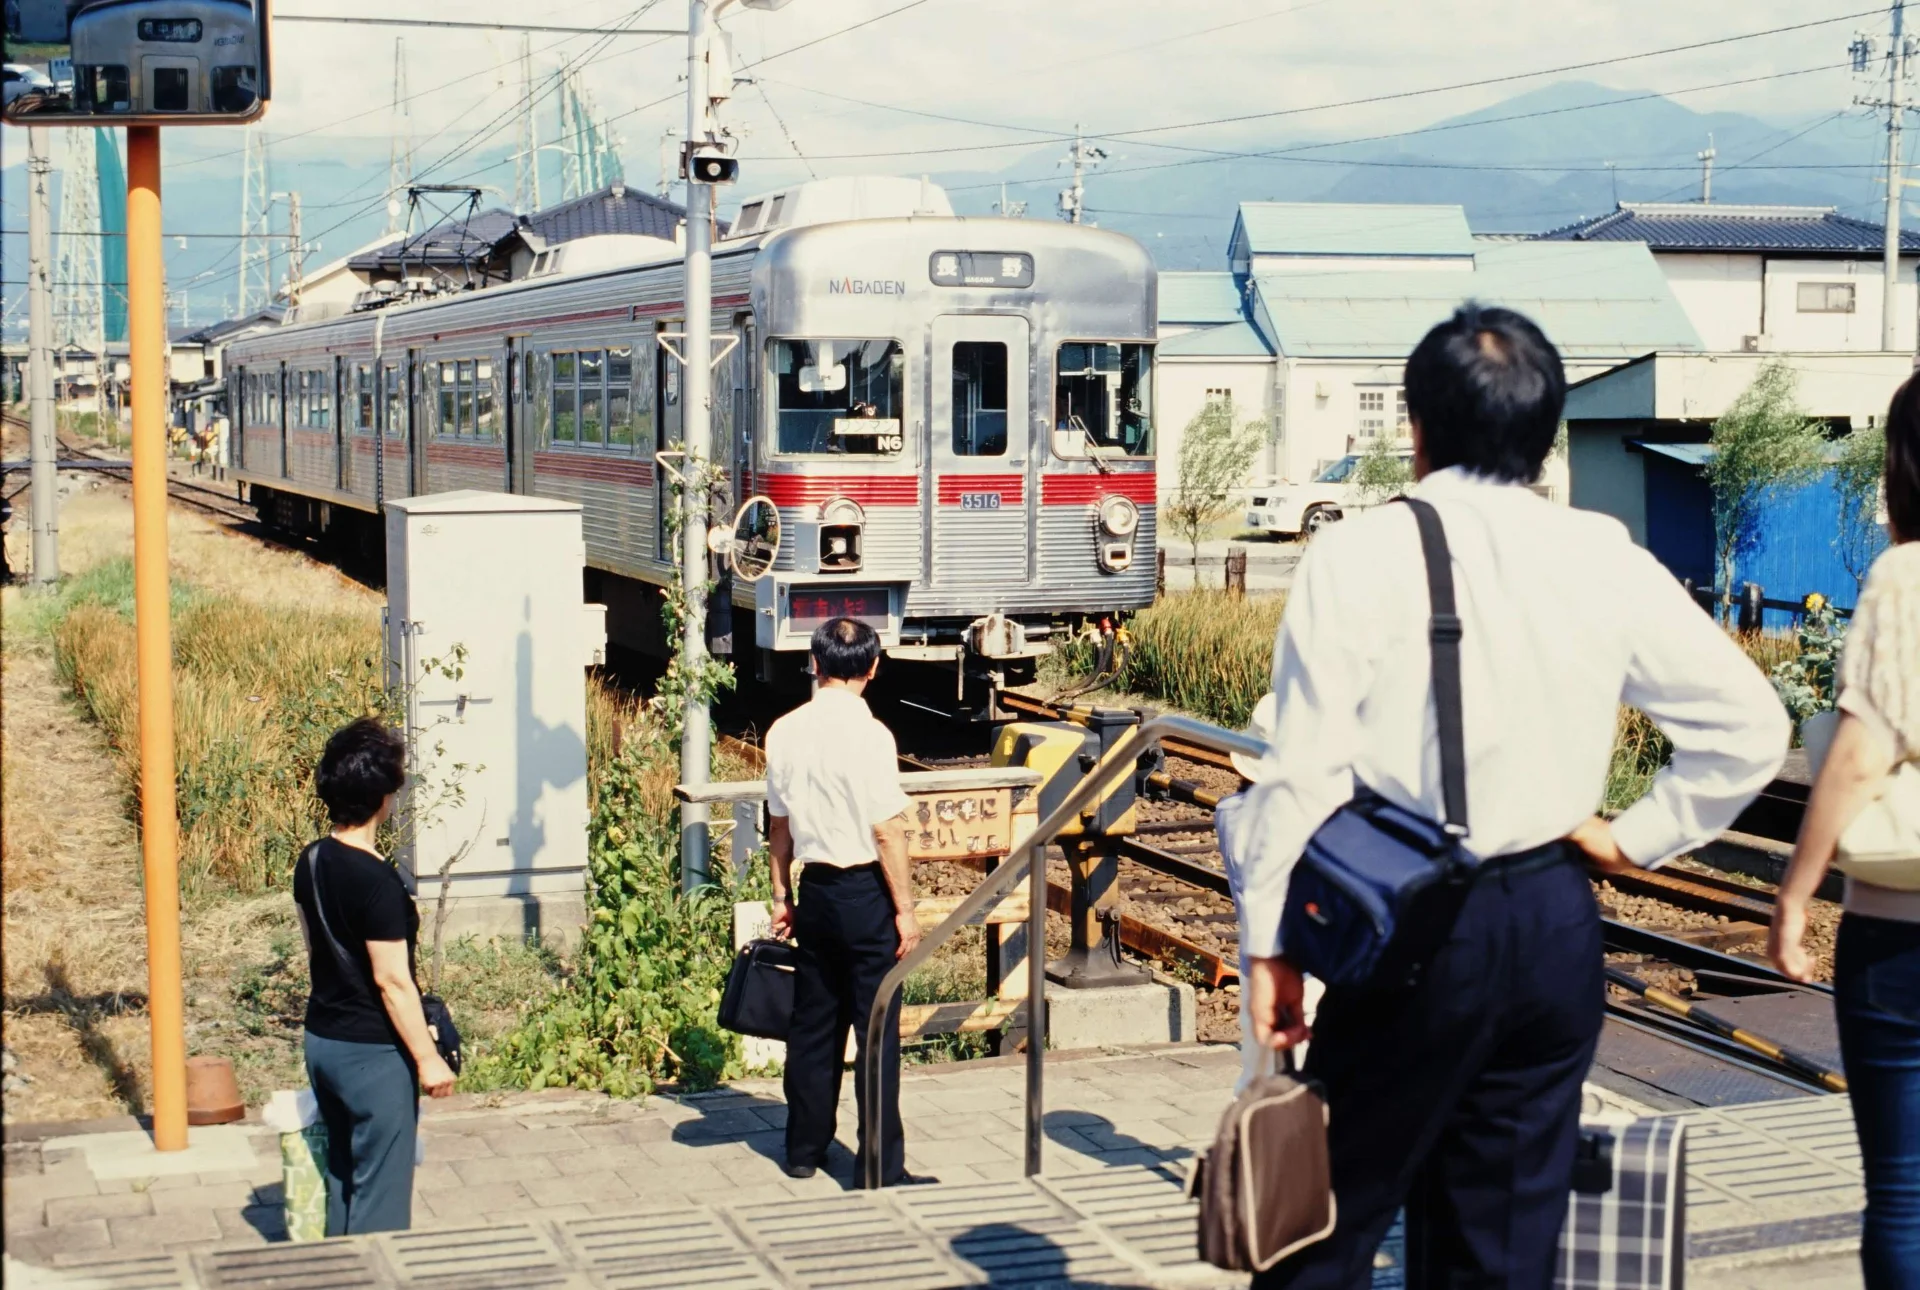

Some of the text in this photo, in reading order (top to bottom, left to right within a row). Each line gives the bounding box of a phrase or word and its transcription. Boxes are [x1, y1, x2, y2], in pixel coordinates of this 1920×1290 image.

[829, 277, 905, 295] NAGADEN
[964, 276, 995, 284] NAGANO
[838, 420, 894, 433] ワンマン
[877, 435, 903, 450] N6
[964, 494, 998, 508] 3516
